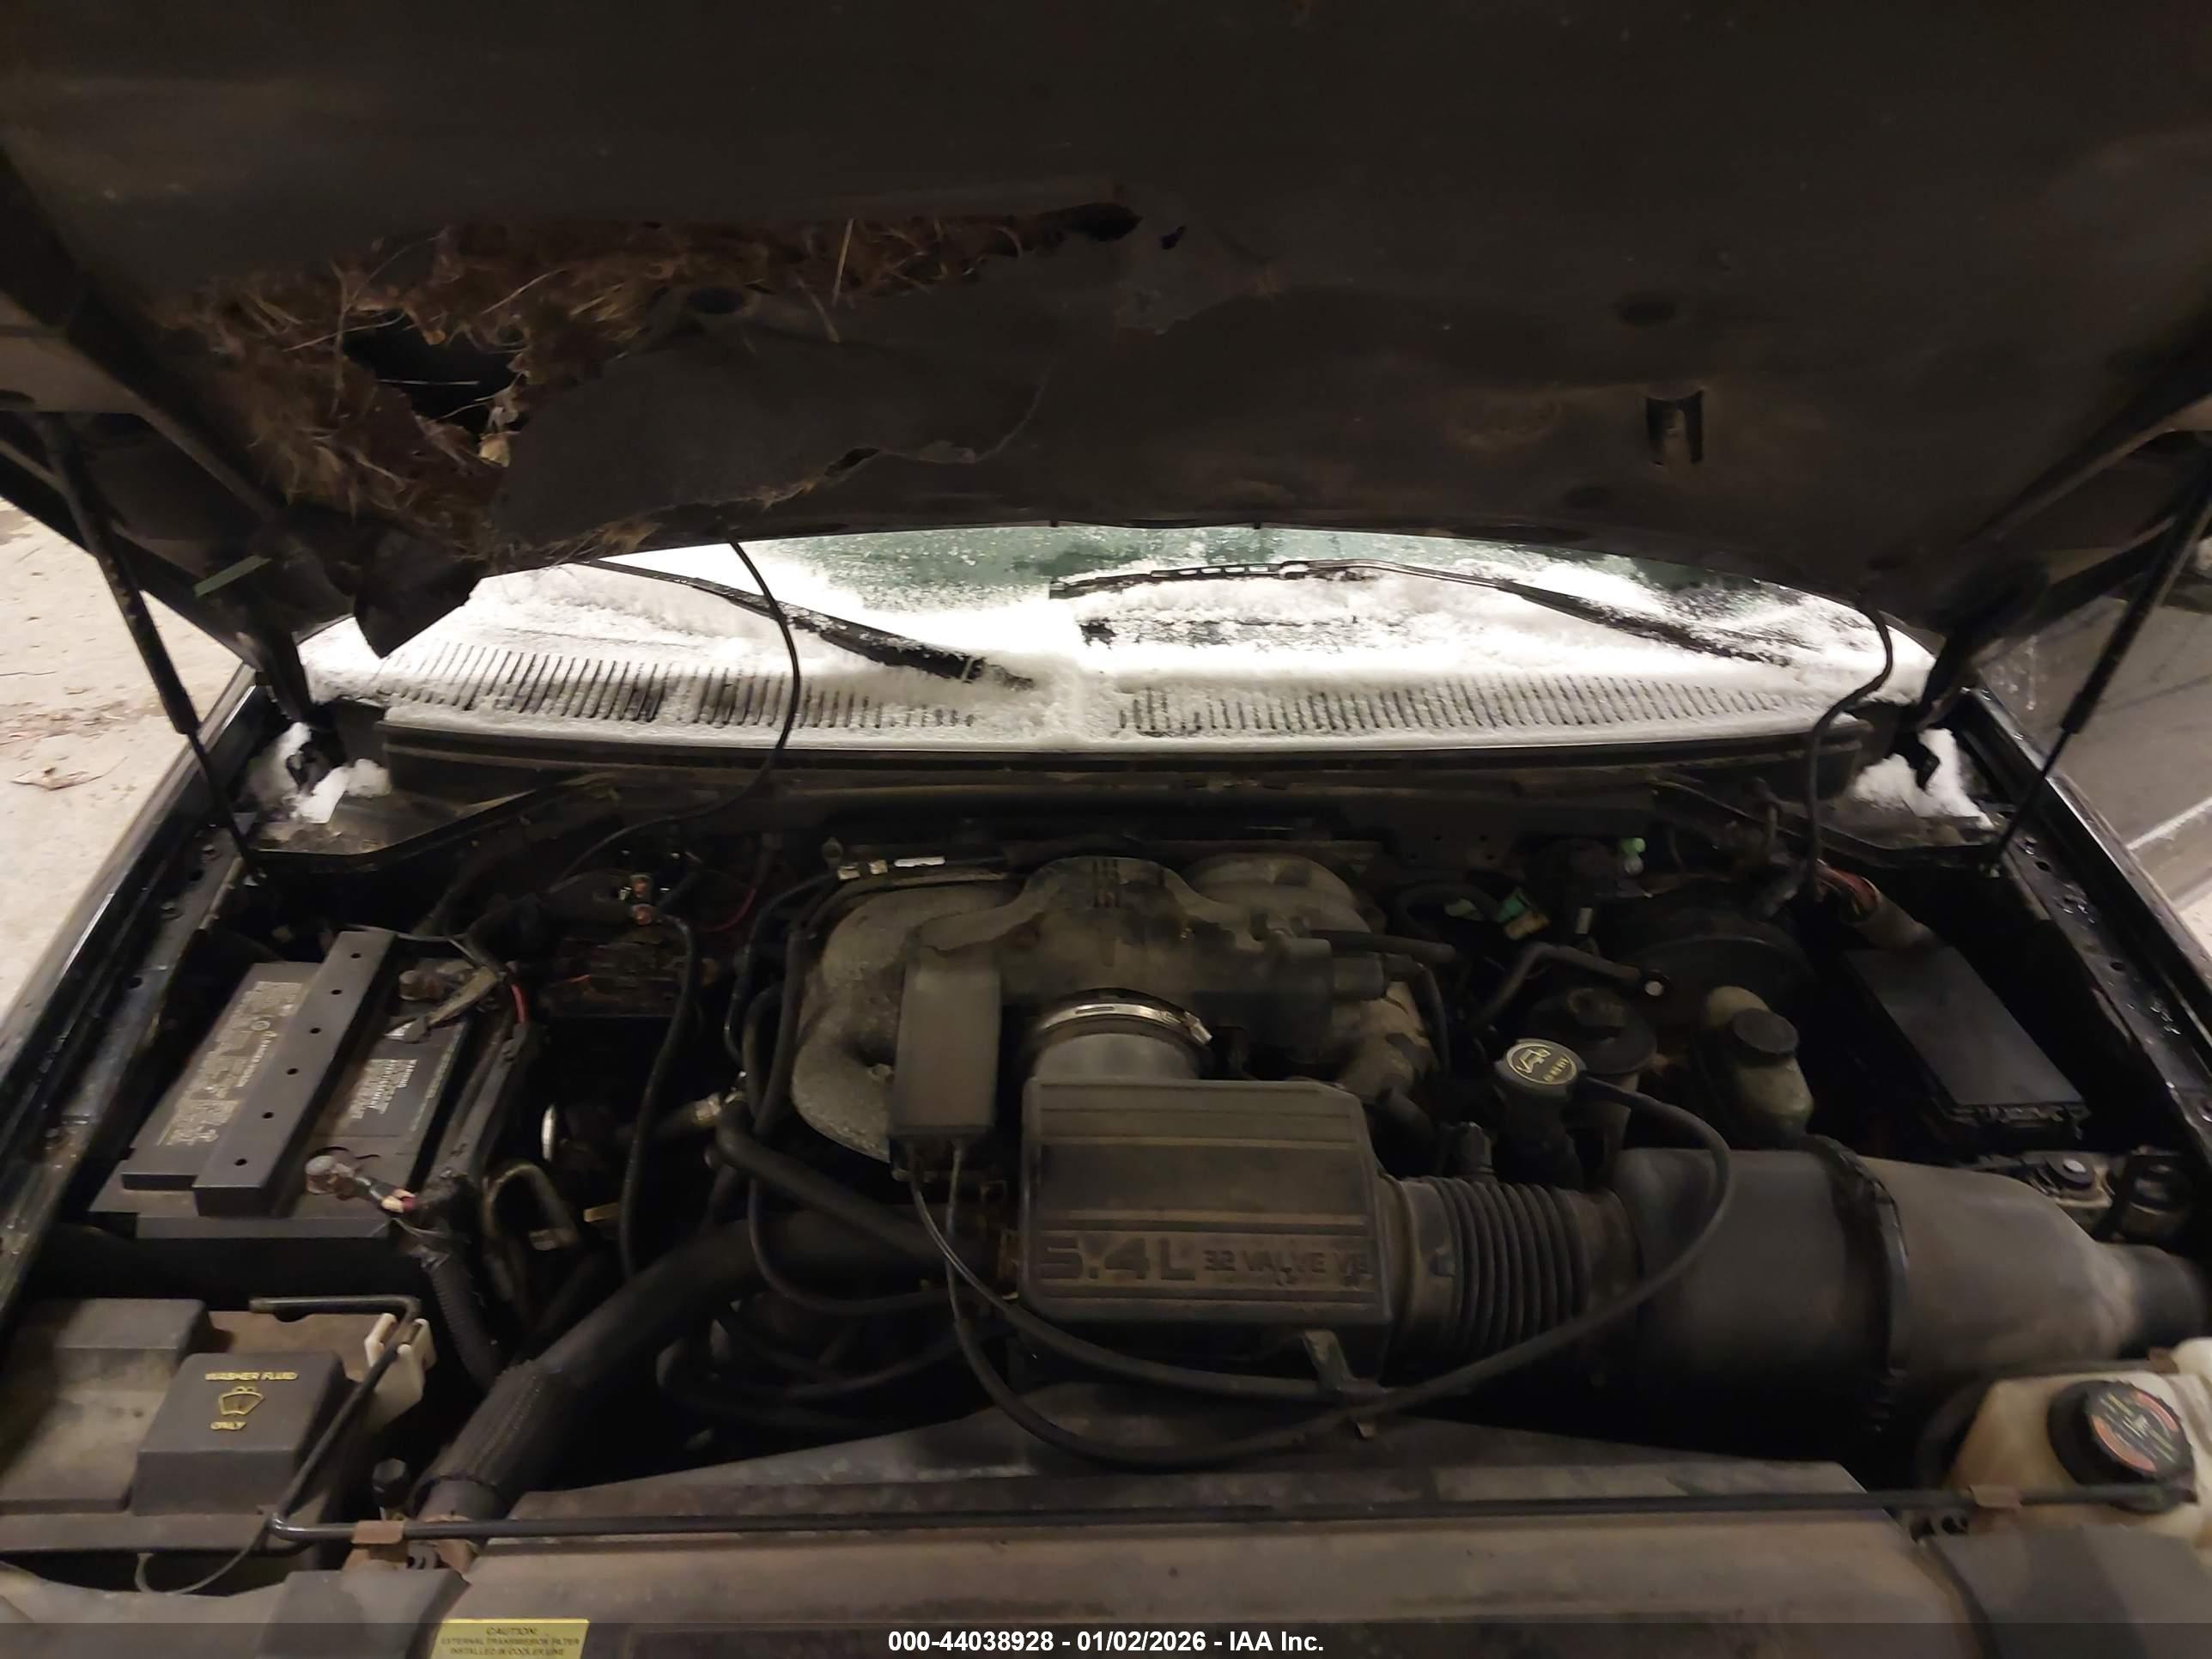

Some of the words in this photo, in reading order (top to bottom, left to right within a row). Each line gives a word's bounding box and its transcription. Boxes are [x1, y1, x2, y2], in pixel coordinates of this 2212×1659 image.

[1037, 1237, 1196, 1280] 5.4L
[1202, 1249, 1237, 1273] 32
[205, 1372, 259, 1381] WASHER
[261, 1372, 298, 1381] FLUID
[210, 1422, 246, 1431] ONLY
